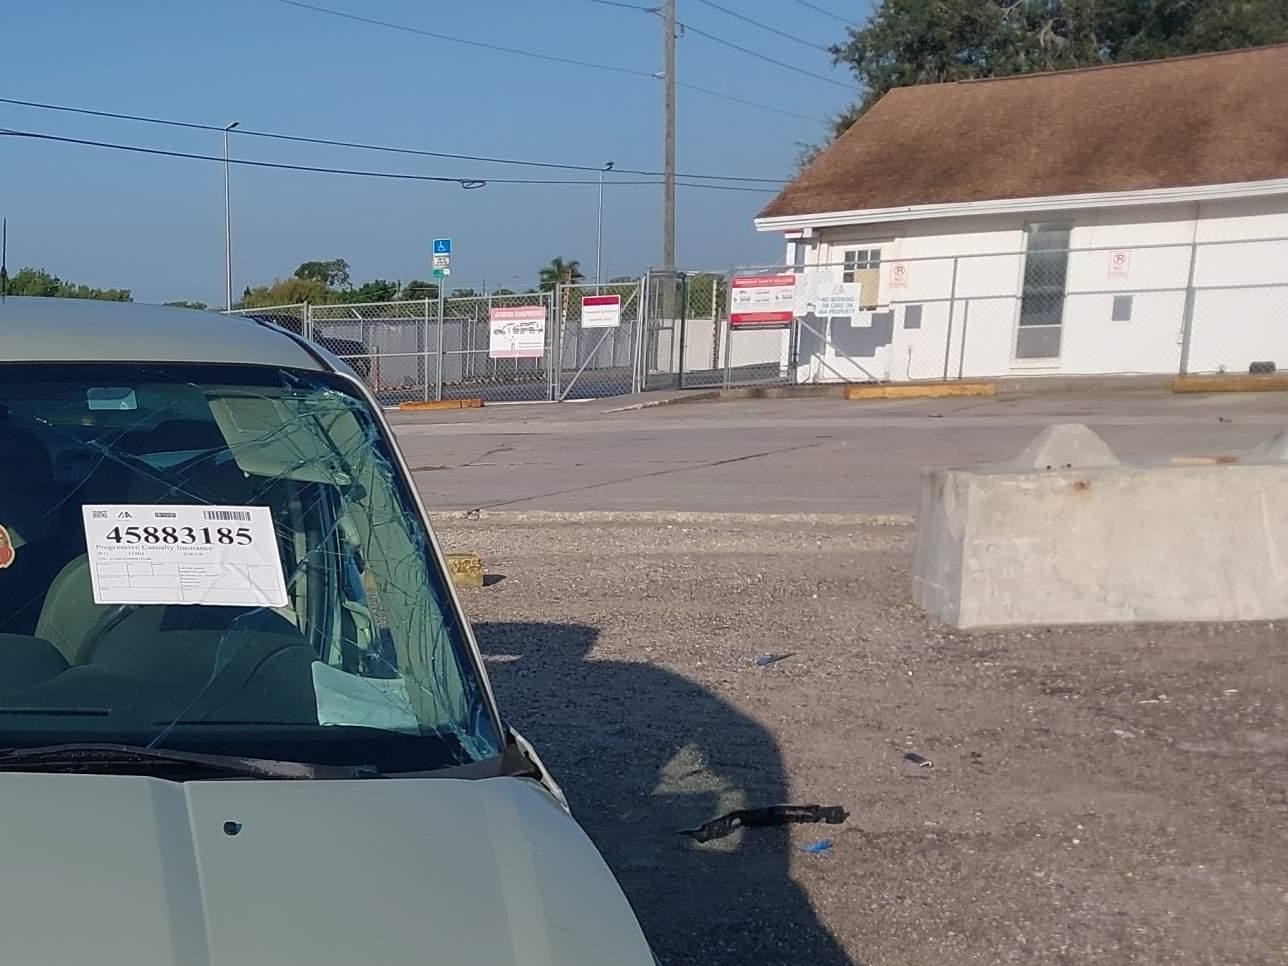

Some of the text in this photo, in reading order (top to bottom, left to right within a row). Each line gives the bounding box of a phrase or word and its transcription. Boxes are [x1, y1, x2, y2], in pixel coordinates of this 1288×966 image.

[106, 526, 253, 546] 45883185
[95, 544, 141, 552] Progressive
[142, 544, 174, 552] Casualty
